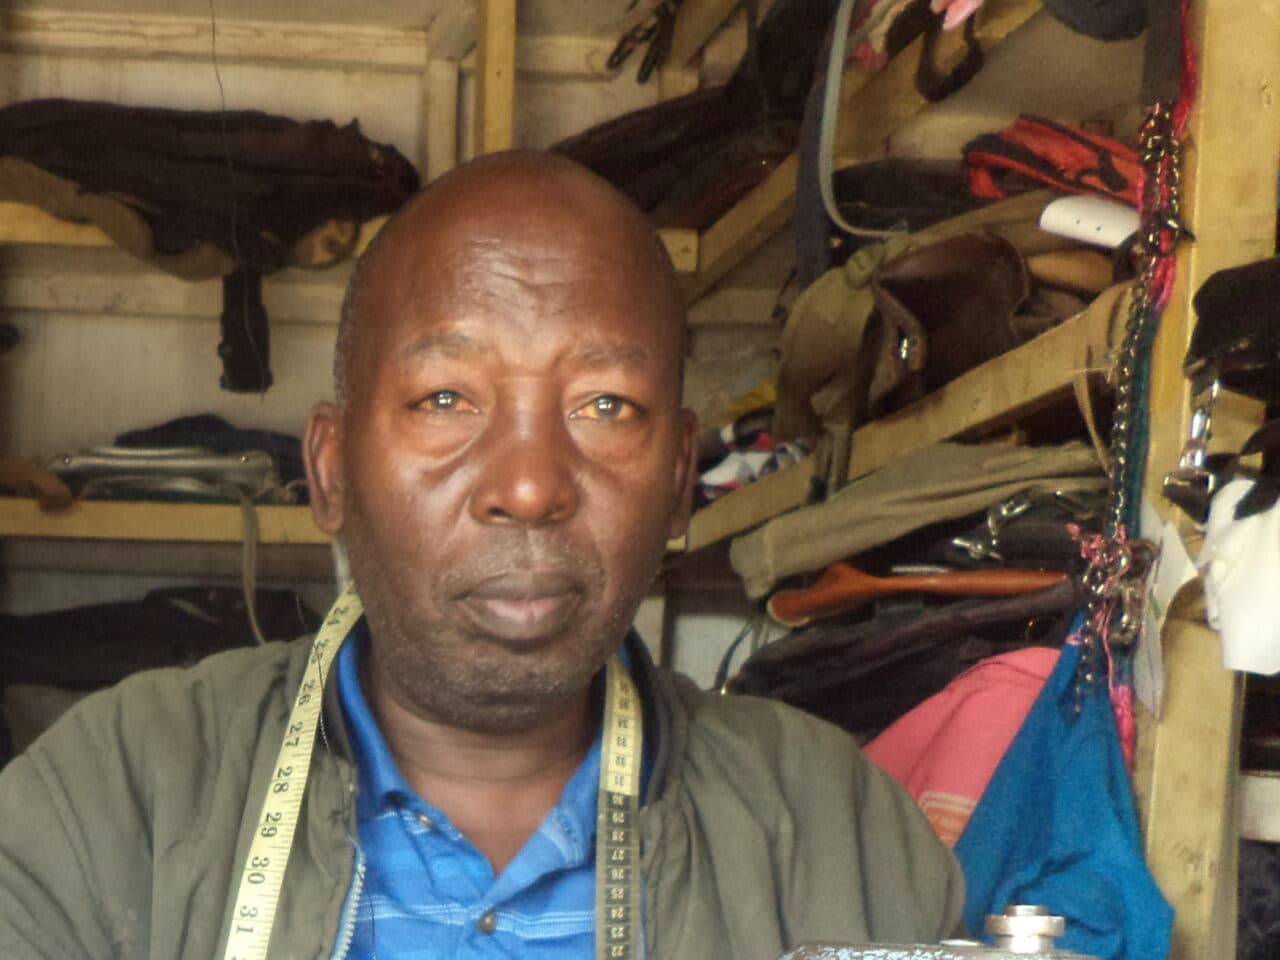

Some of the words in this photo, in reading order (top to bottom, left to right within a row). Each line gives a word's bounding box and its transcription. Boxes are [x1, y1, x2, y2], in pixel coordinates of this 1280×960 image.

[298, 679, 316, 706] 26
[286, 721, 303, 748] 27
[273, 765, 293, 794] 28
[612, 812, 625, 823] 29
[261, 811, 282, 838] 29
[611, 830, 625, 842] 28
[611, 849, 625, 861] 27
[247, 856, 270, 885] 30
[611, 868, 625, 880] 26
[610, 887, 625, 899] 25
[611, 907, 625, 919] 24
[236, 905, 258, 934] 31
[611, 926, 625, 938] 23
[611, 945, 625, 957] 22
